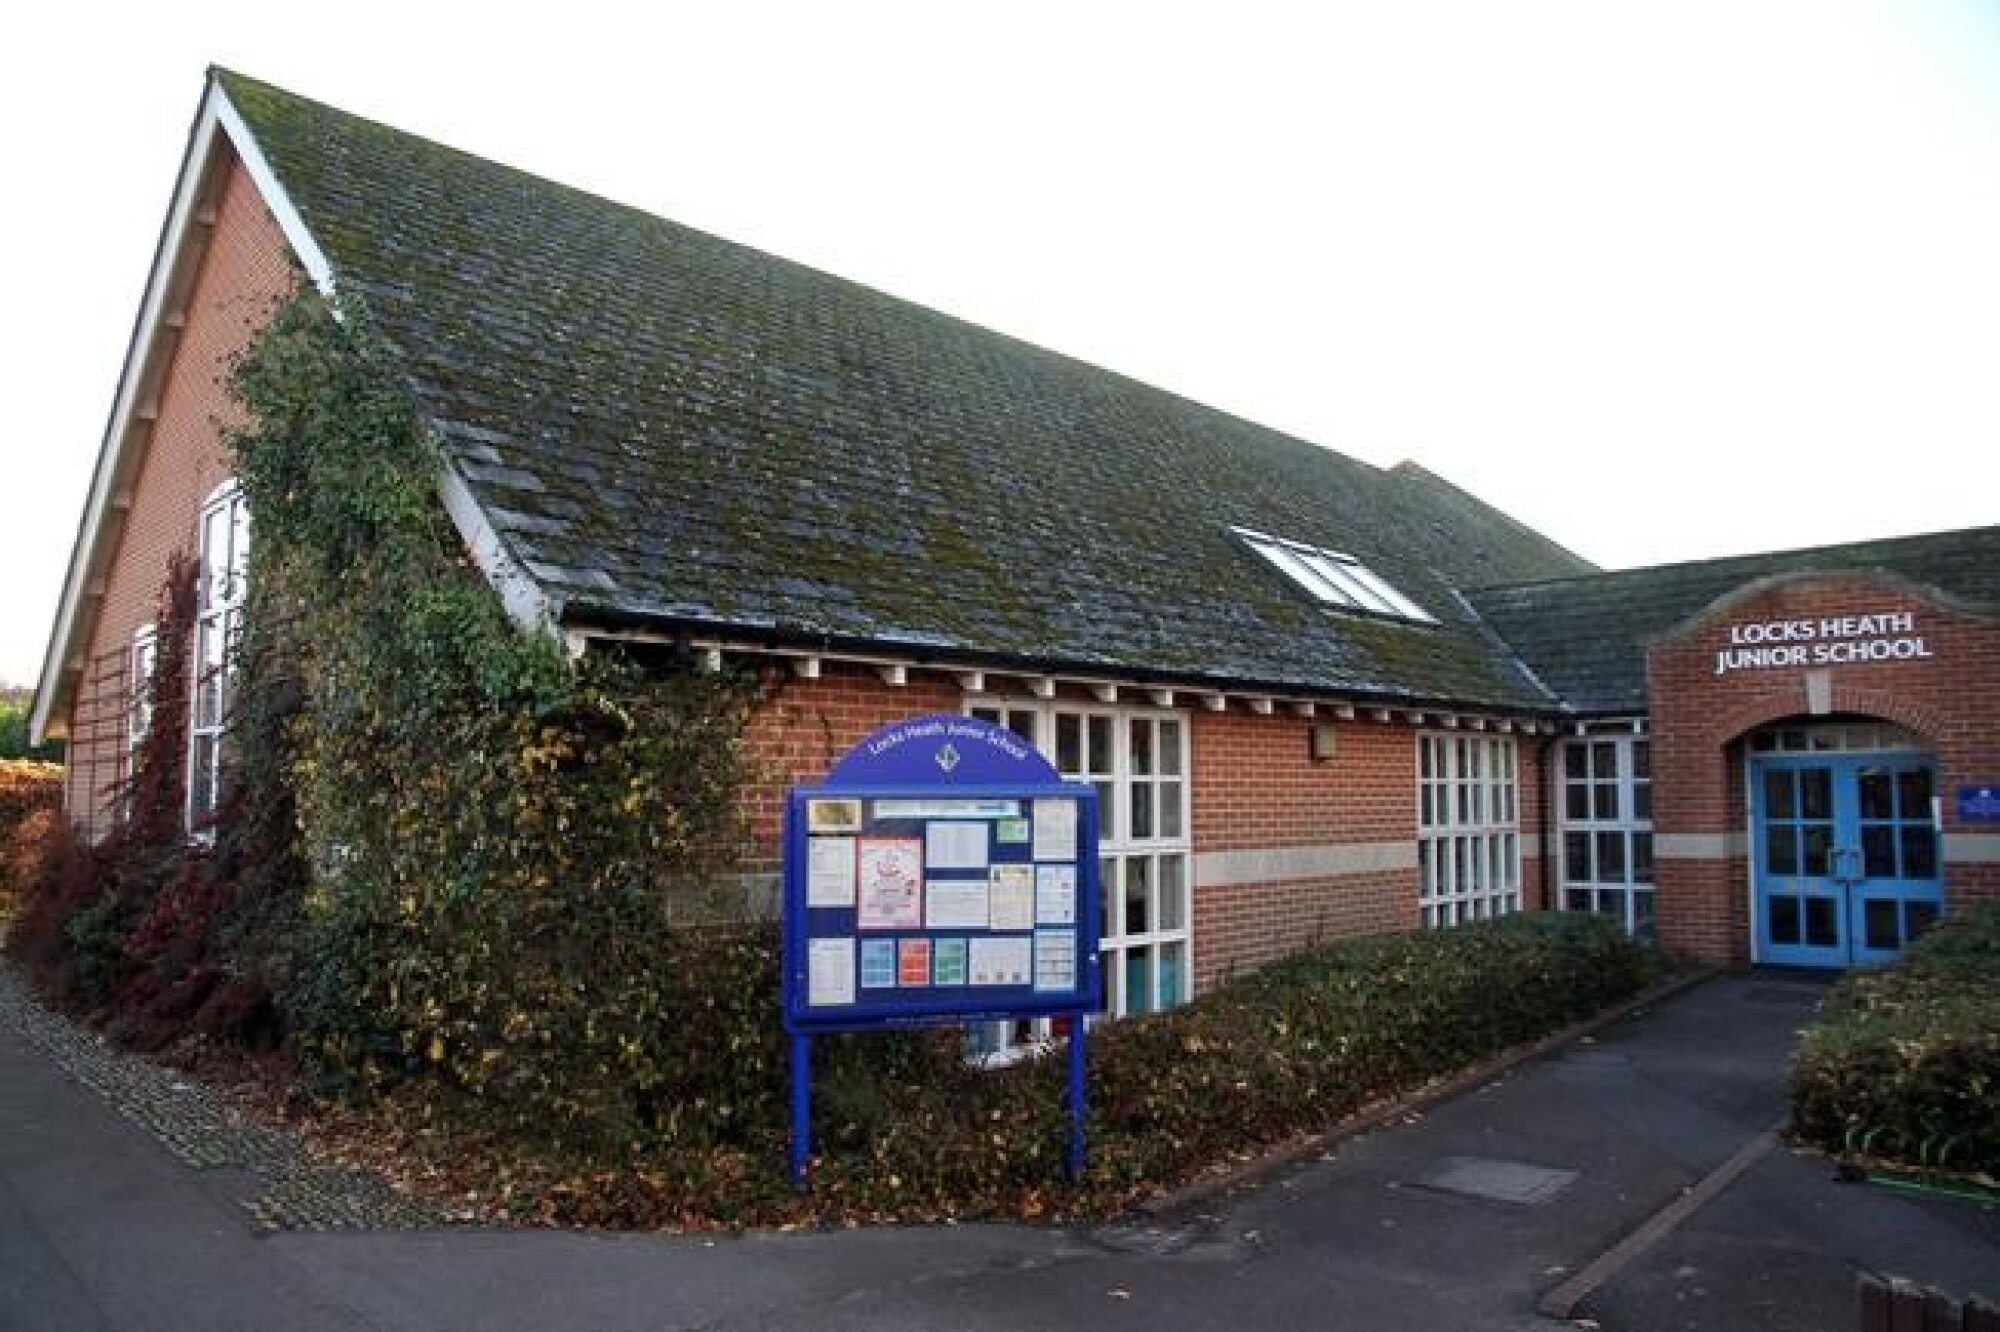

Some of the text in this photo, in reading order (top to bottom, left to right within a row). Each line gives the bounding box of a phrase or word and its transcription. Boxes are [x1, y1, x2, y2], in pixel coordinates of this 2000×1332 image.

[1731, 611, 1913, 644] LOCKS HEATH
[1714, 637, 1934, 675] JUNIOR SCHOOL
